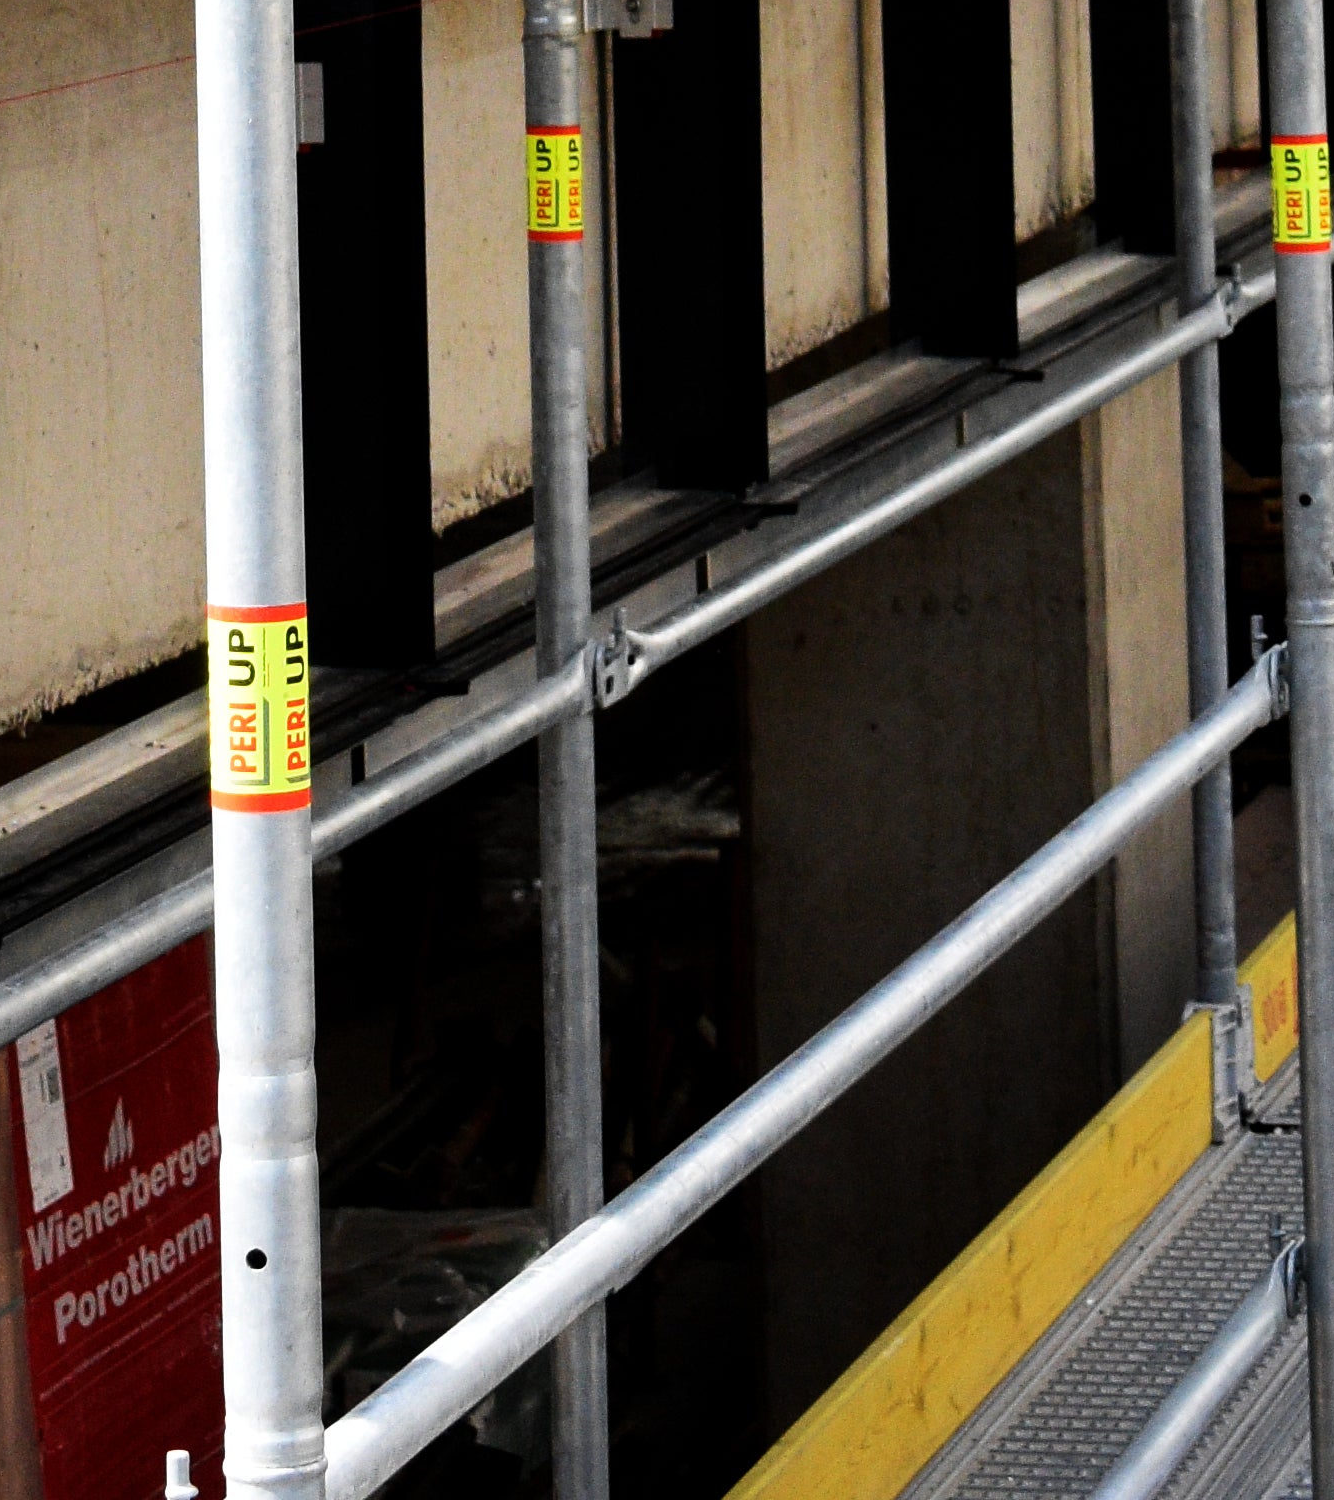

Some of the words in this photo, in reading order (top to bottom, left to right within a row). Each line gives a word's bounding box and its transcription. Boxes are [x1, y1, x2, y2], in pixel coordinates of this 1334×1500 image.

[535, 138, 552, 173] UP
[568, 138, 580, 172] UP
[1284, 148, 1302, 183] UP
[536, 179, 552, 220] PERI
[1286, 190, 1303, 232] PERI
[228, 628, 256, 687] UP
[285, 625, 305, 686] UP
[229, 702, 258, 773] PERI
[286, 697, 308, 771] PERI
[25, 1123, 220, 1272] Wienerberger
[53, 1213, 214, 1346] Porotherm
